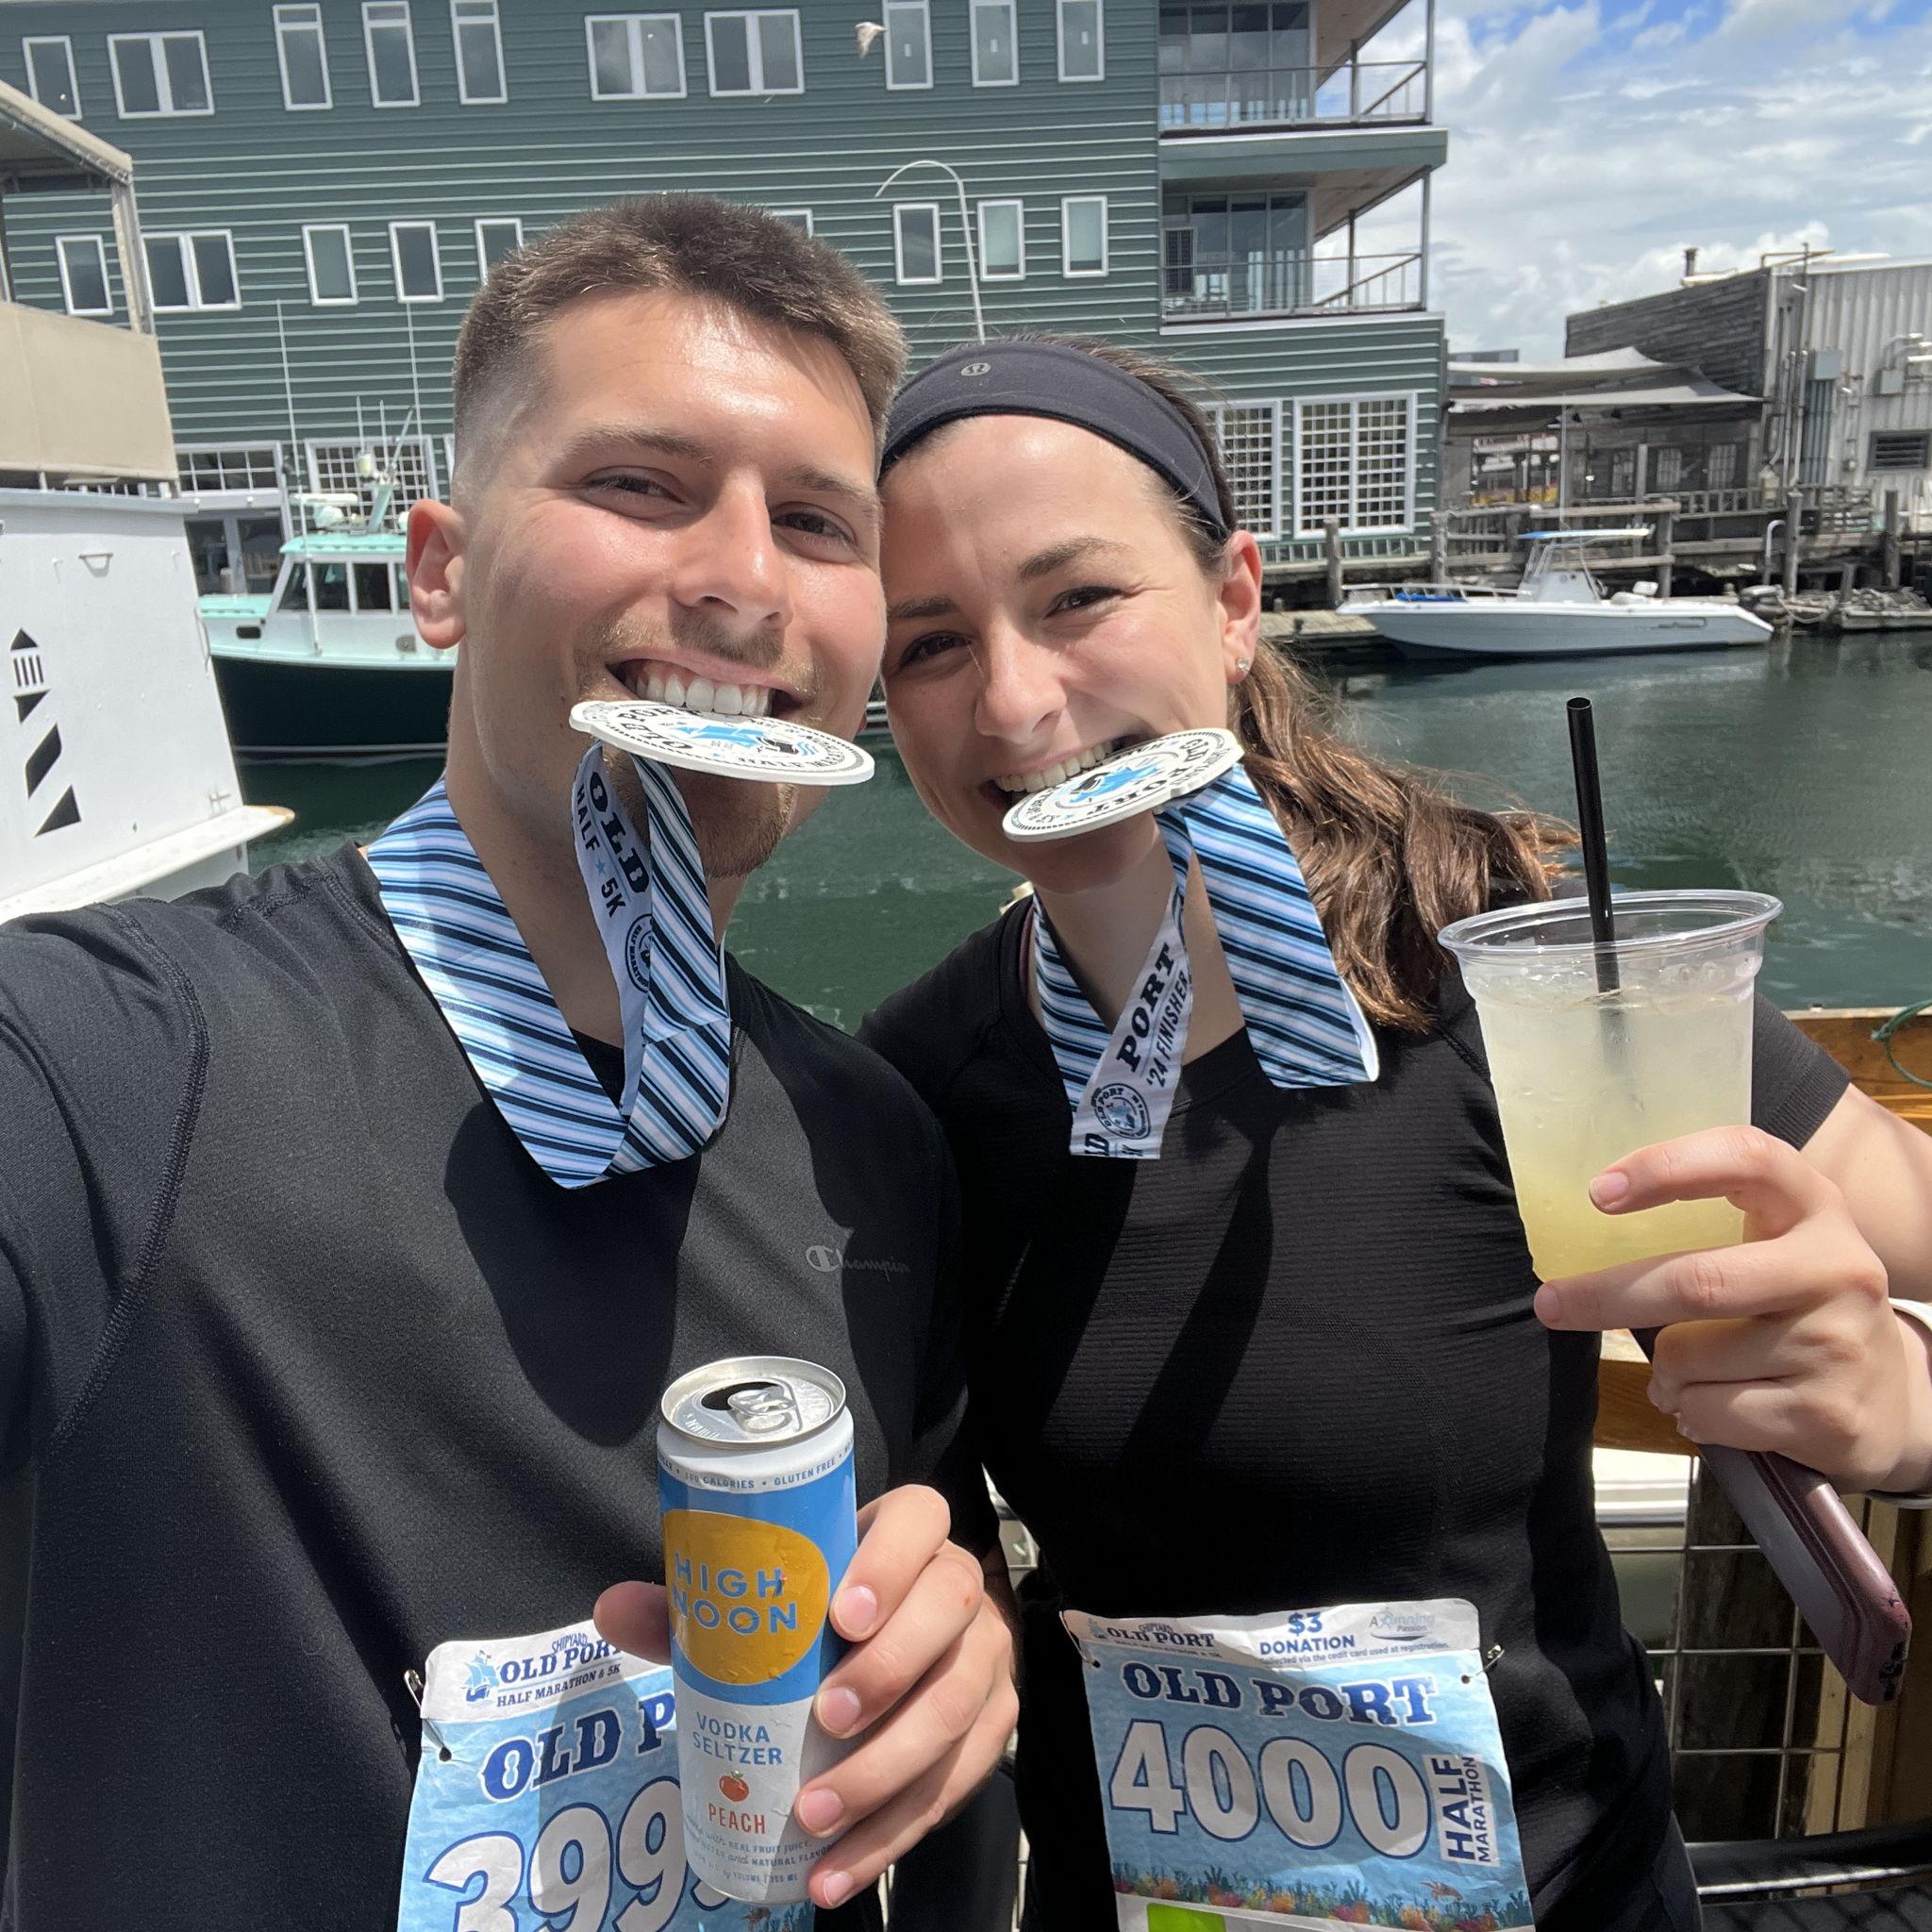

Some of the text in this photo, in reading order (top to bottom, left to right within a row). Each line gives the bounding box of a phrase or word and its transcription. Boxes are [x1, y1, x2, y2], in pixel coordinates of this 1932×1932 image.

[590, 771, 649, 893] OLD
[575, 784, 626, 918] HALF 5K
[1116, 941, 1176, 1073] PORT
[1147, 969, 1191, 1088] '24 FINISHER
[1099, 1087, 1124, 1106] PORT
[703, 1476, 755, 1489] CALORIES
[774, 1469, 814, 1486] GLUTEN
[816, 1457, 837, 1474] FREE
[674, 1552, 787, 1599] HIGH
[670, 1581, 799, 1636] NOON
[1288, 1611, 1324, 1637] $3
[1369, 1616, 1379, 1628] A
[551, 1633, 589, 1654] SHIPYARD
[1106, 1627, 1215, 1648] OLD PORT
[1259, 1634, 1356, 1656] DONATION
[1396, 1624, 1427, 1633] Passion
[500, 1655, 557, 1684] OLD
[1313, 1653, 1326, 1662] the
[1351, 1649, 1368, 1658] card
[1370, 1646, 1389, 1656] used
[1391, 1645, 1399, 1654] at
[496, 1690, 533, 1707] HALF
[535, 1670, 596, 1699] MARATHON
[607, 1663, 621, 1676] 5K
[1122, 1661, 1438, 1726] OLD PORT
[696, 1711, 771, 1743] VODKA
[482, 1709, 623, 1800] OLD
[692, 1731, 783, 1766] SELTZER
[1108, 1719, 1432, 1859] 4000
[708, 1803, 766, 1835] PEACH
[1431, 1757, 1475, 1860] HALF
[1462, 1757, 1491, 1862] MARATHON
[423, 1775, 730, 1932] 399
[752, 1857, 796, 1867] NATURAL
[754, 1844, 781, 1854] FRUIT
